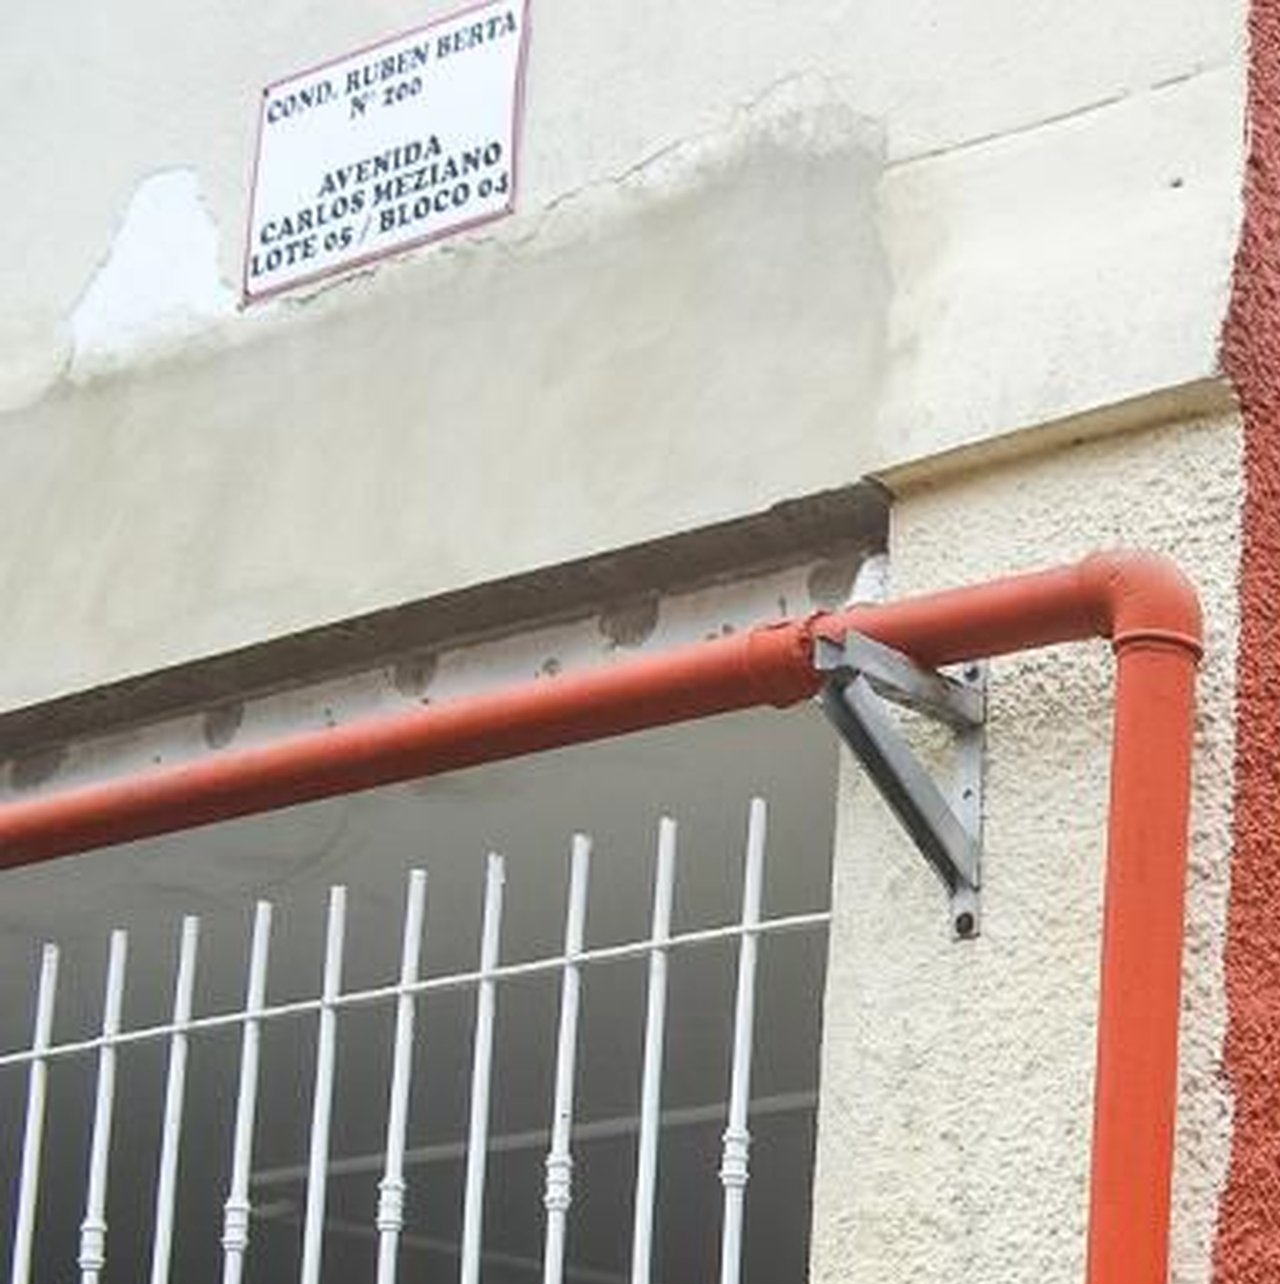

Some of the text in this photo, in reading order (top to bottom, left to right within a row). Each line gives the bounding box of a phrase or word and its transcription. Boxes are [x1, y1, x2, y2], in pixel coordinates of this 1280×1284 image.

[267, 11, 516, 123] COND. RUBEN BERTA
[260, 142, 502, 244] CARLOS MEZIANO
[318, 135, 441, 197] AVENIDA
[251, 237, 317, 277] LOTE
[323, 227, 354, 251] 05
[380, 181, 471, 232] BLOCO
